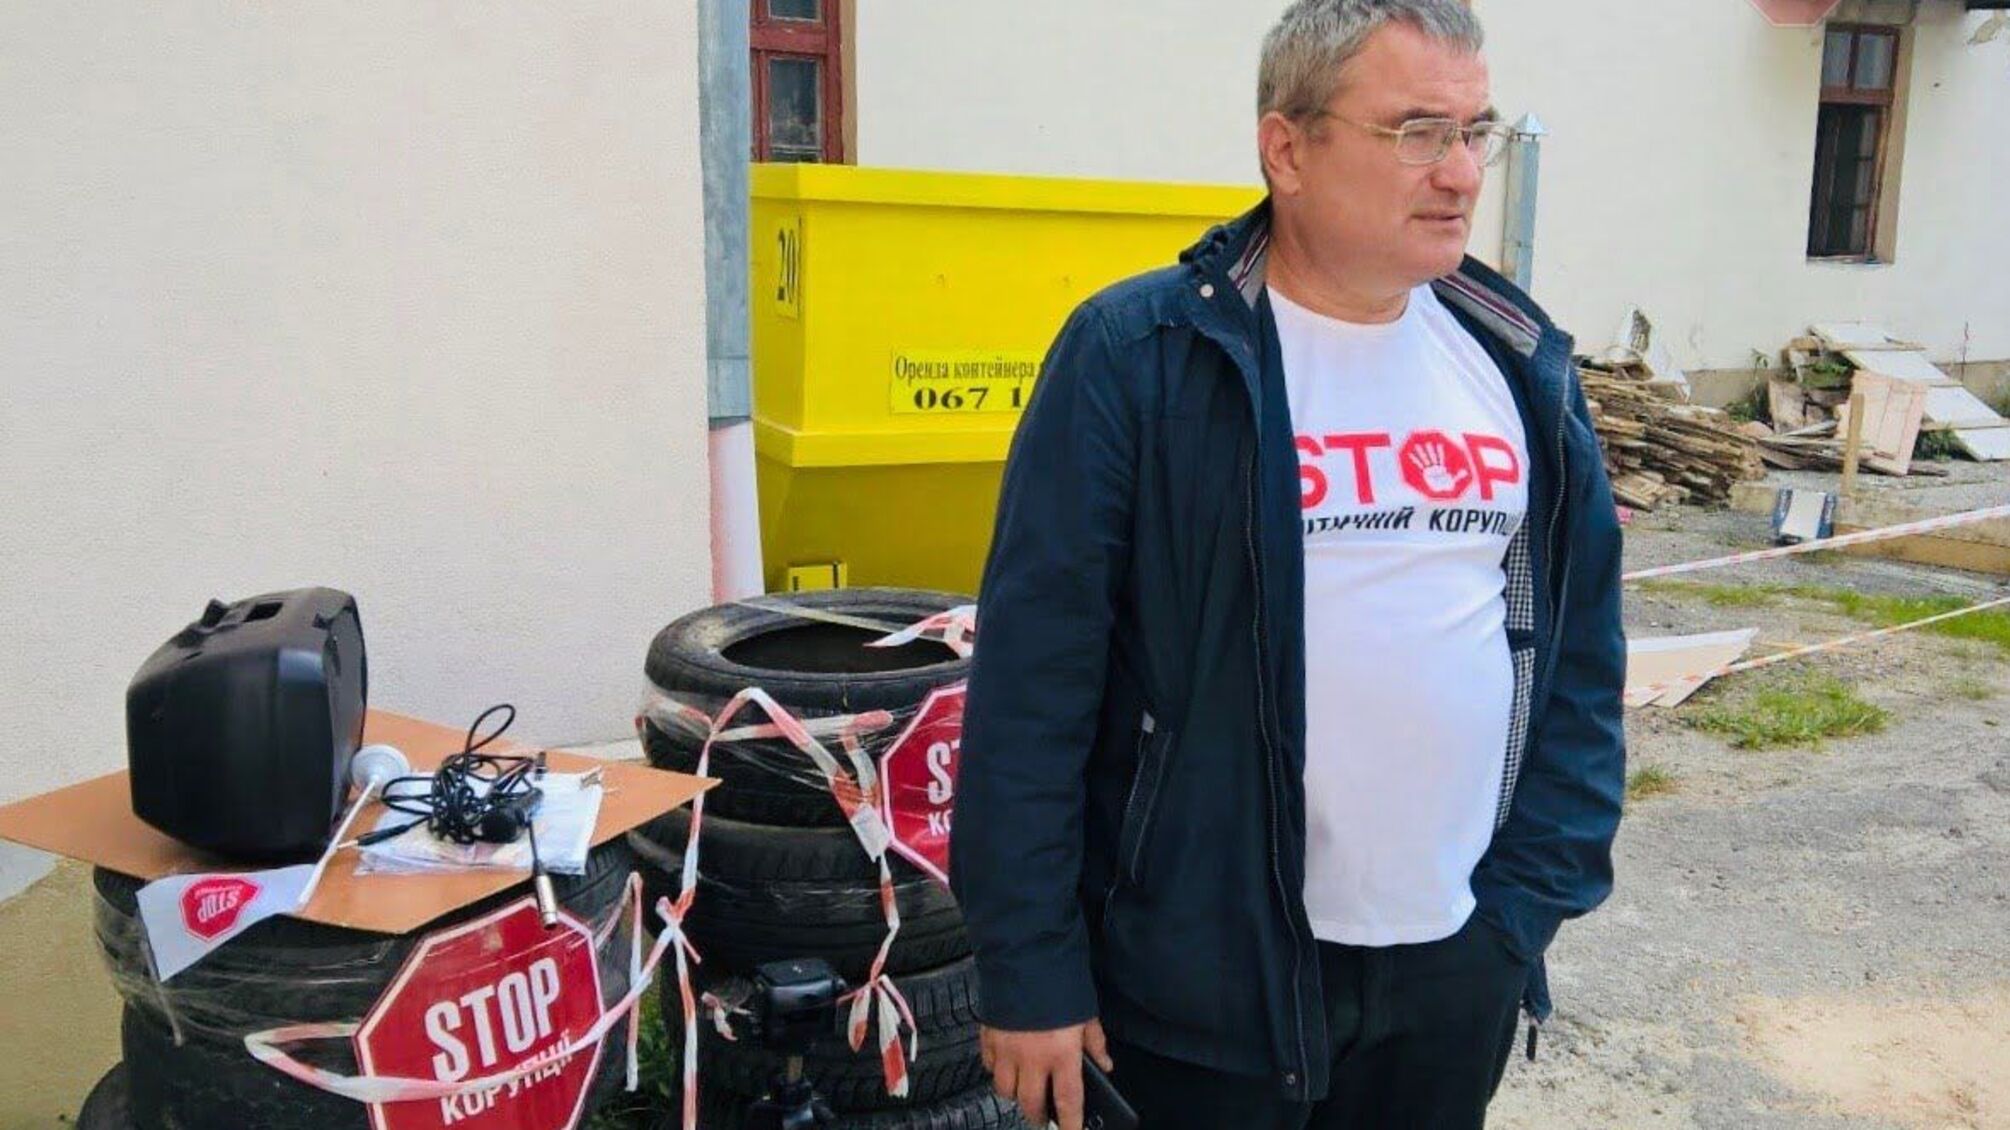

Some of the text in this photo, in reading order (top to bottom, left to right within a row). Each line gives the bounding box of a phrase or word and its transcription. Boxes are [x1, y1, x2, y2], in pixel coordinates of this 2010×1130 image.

[895, 356, 1035, 386] Оренда контейнера
[914, 387, 989, 409] 067
[1294, 431, 1519, 509] STOP
[197, 889, 240, 923] STOP
[424, 957, 561, 1083] STOP
